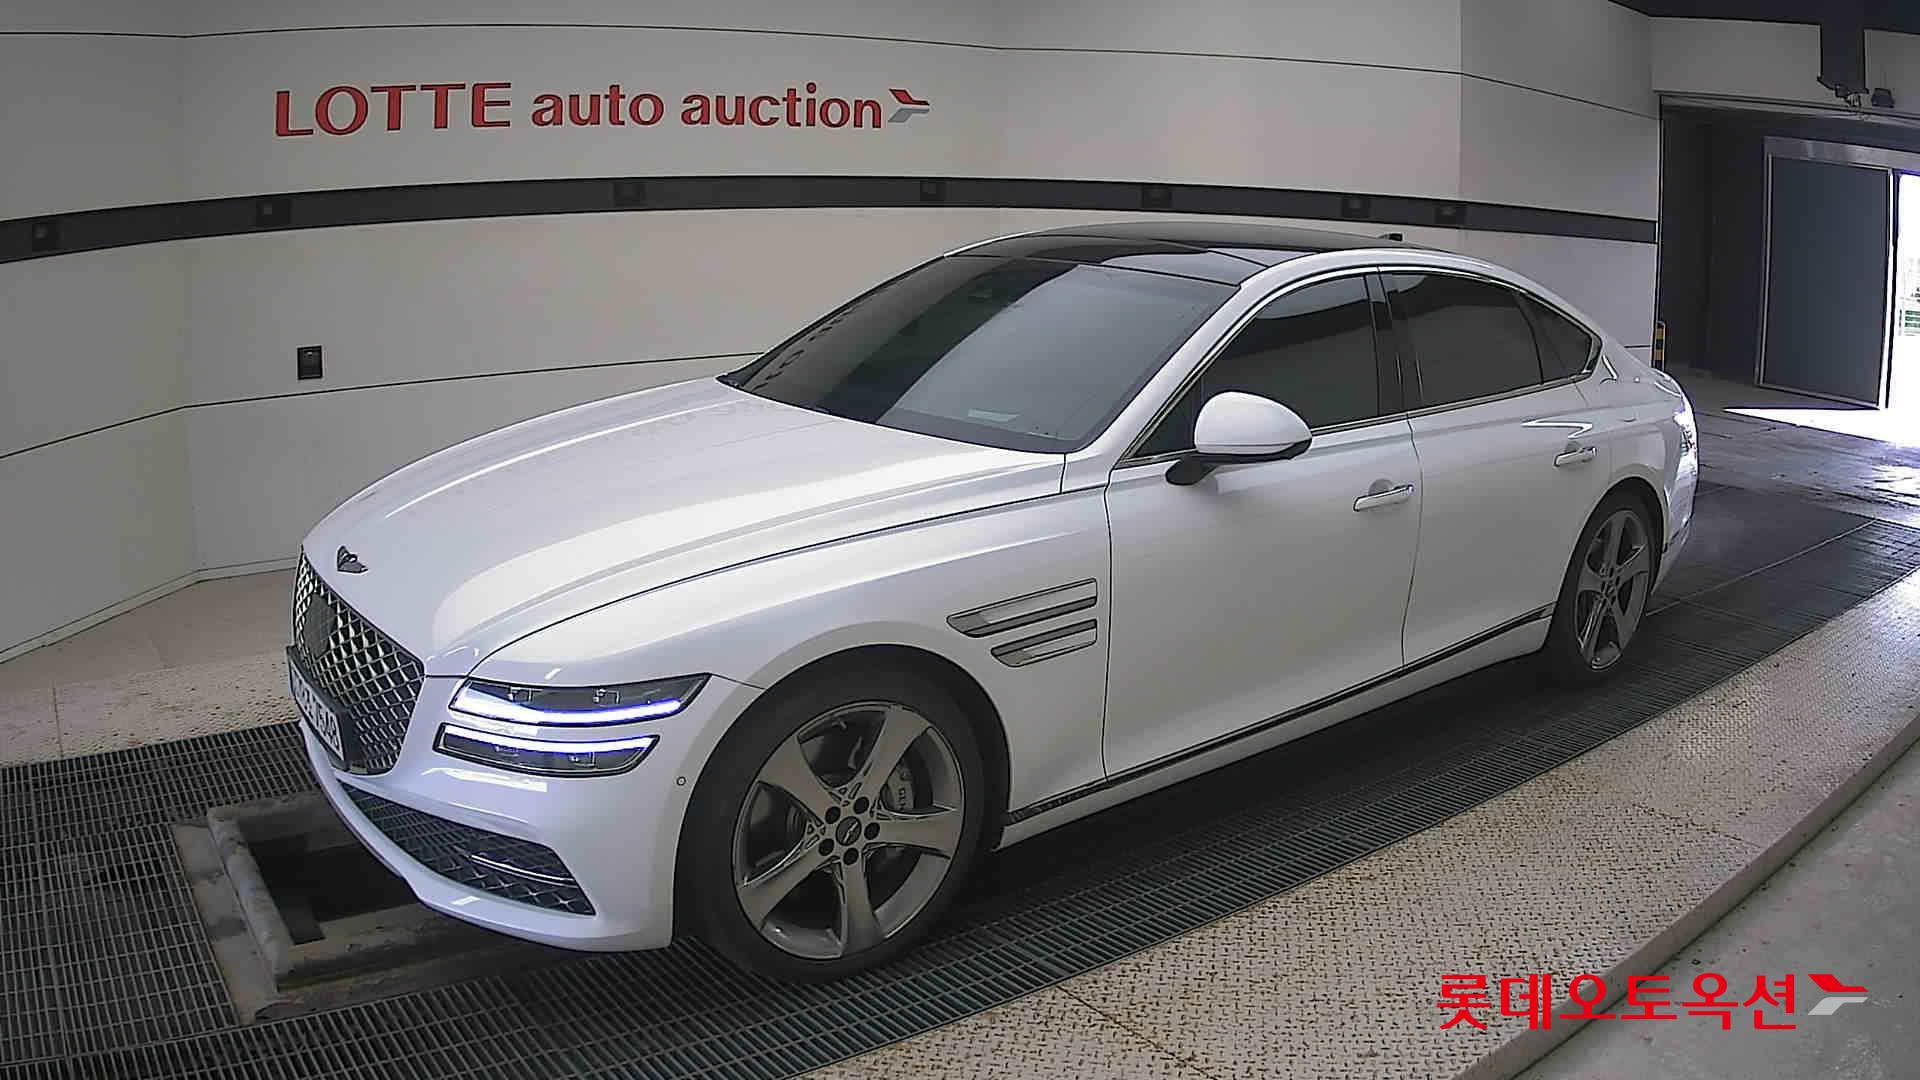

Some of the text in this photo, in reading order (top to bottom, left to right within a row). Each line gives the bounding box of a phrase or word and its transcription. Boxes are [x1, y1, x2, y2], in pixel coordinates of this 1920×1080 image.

[275, 82, 882, 137] LOTTE auto auction
